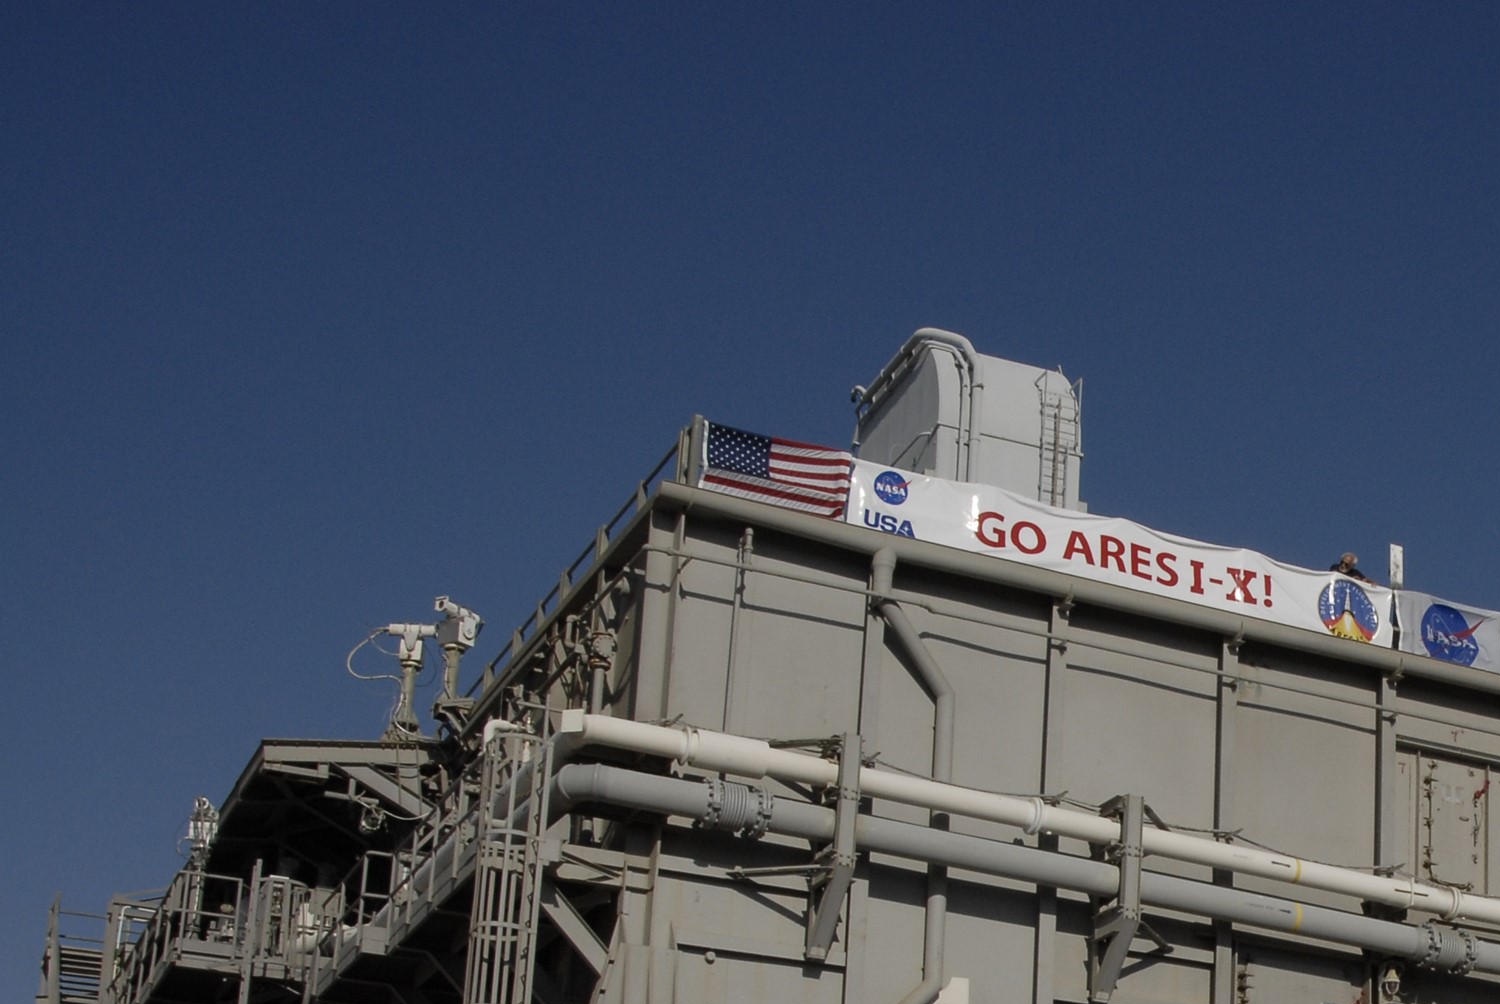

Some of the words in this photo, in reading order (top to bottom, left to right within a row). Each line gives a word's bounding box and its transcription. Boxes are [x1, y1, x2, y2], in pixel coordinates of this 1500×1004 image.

[876, 482, 906, 496] NASA
[864, 508, 916, 539] USA
[975, 511, 1047, 555] GO
[1062, 530, 1179, 587] ARES
[1190, 559, 1273, 608] I-X!
[1426, 624, 1477, 650] NASA
